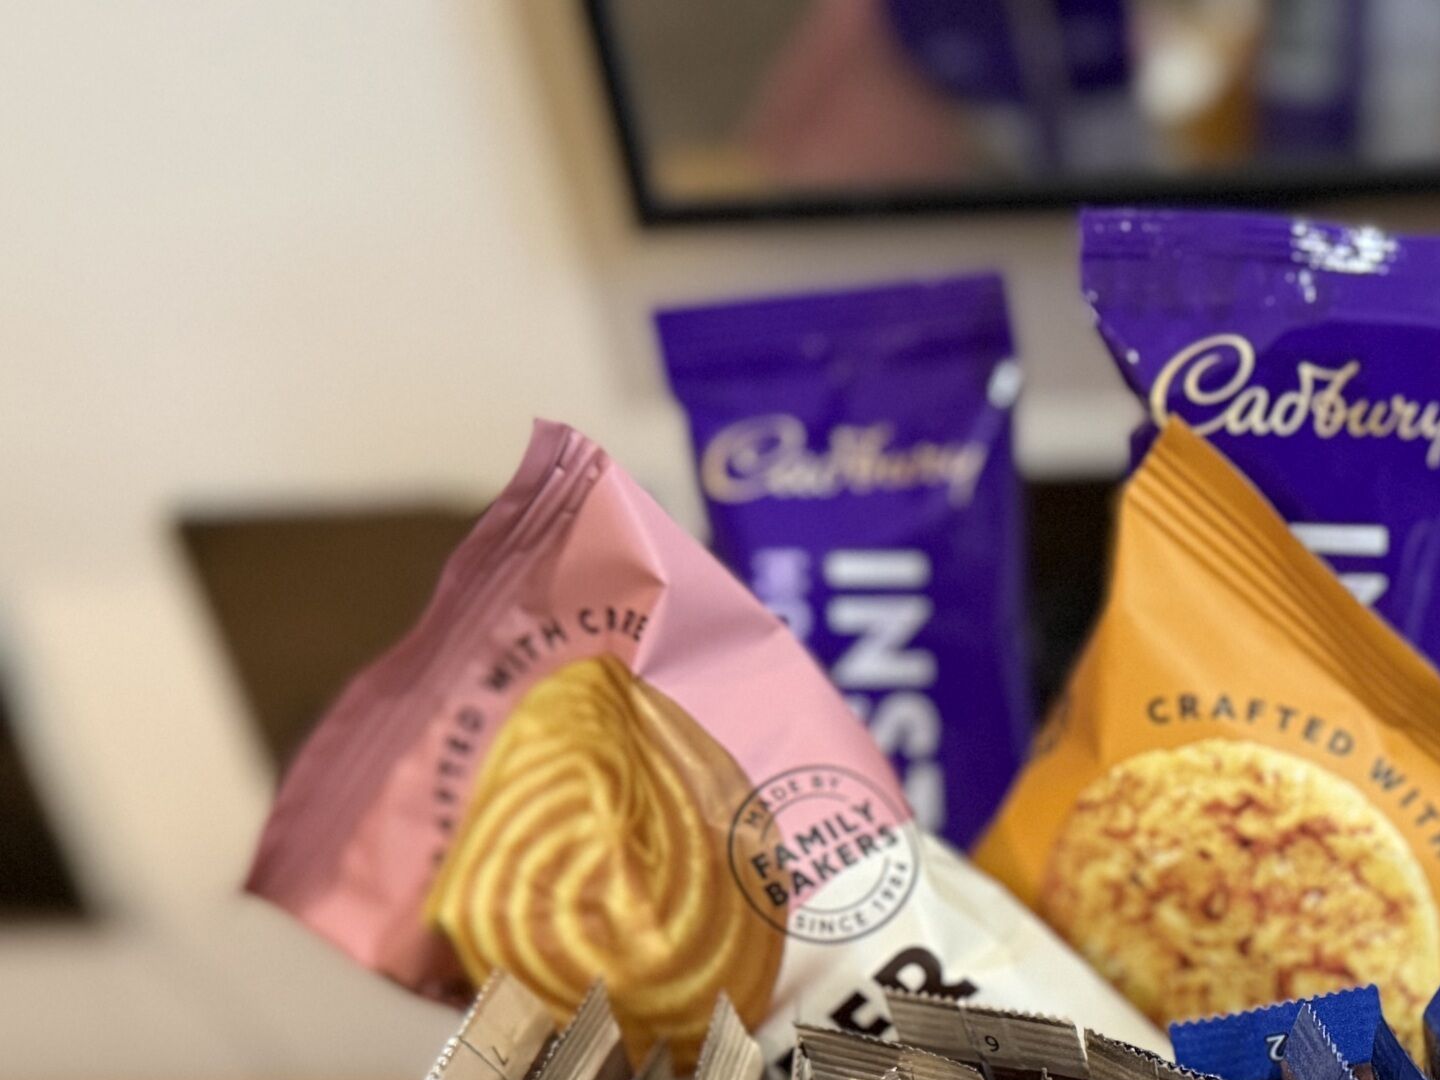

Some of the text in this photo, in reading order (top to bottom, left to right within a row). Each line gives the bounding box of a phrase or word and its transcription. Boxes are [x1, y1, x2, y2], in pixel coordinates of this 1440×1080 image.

[703, 413, 988, 508] Cadbury
[1146, 694, 1355, 758] CRAFTED
[744, 774, 841, 827] MADE BY
[751, 800, 876, 881] FAMILY
[765, 825, 899, 907] BAKERS
[794, 913, 868, 935] SINCE
